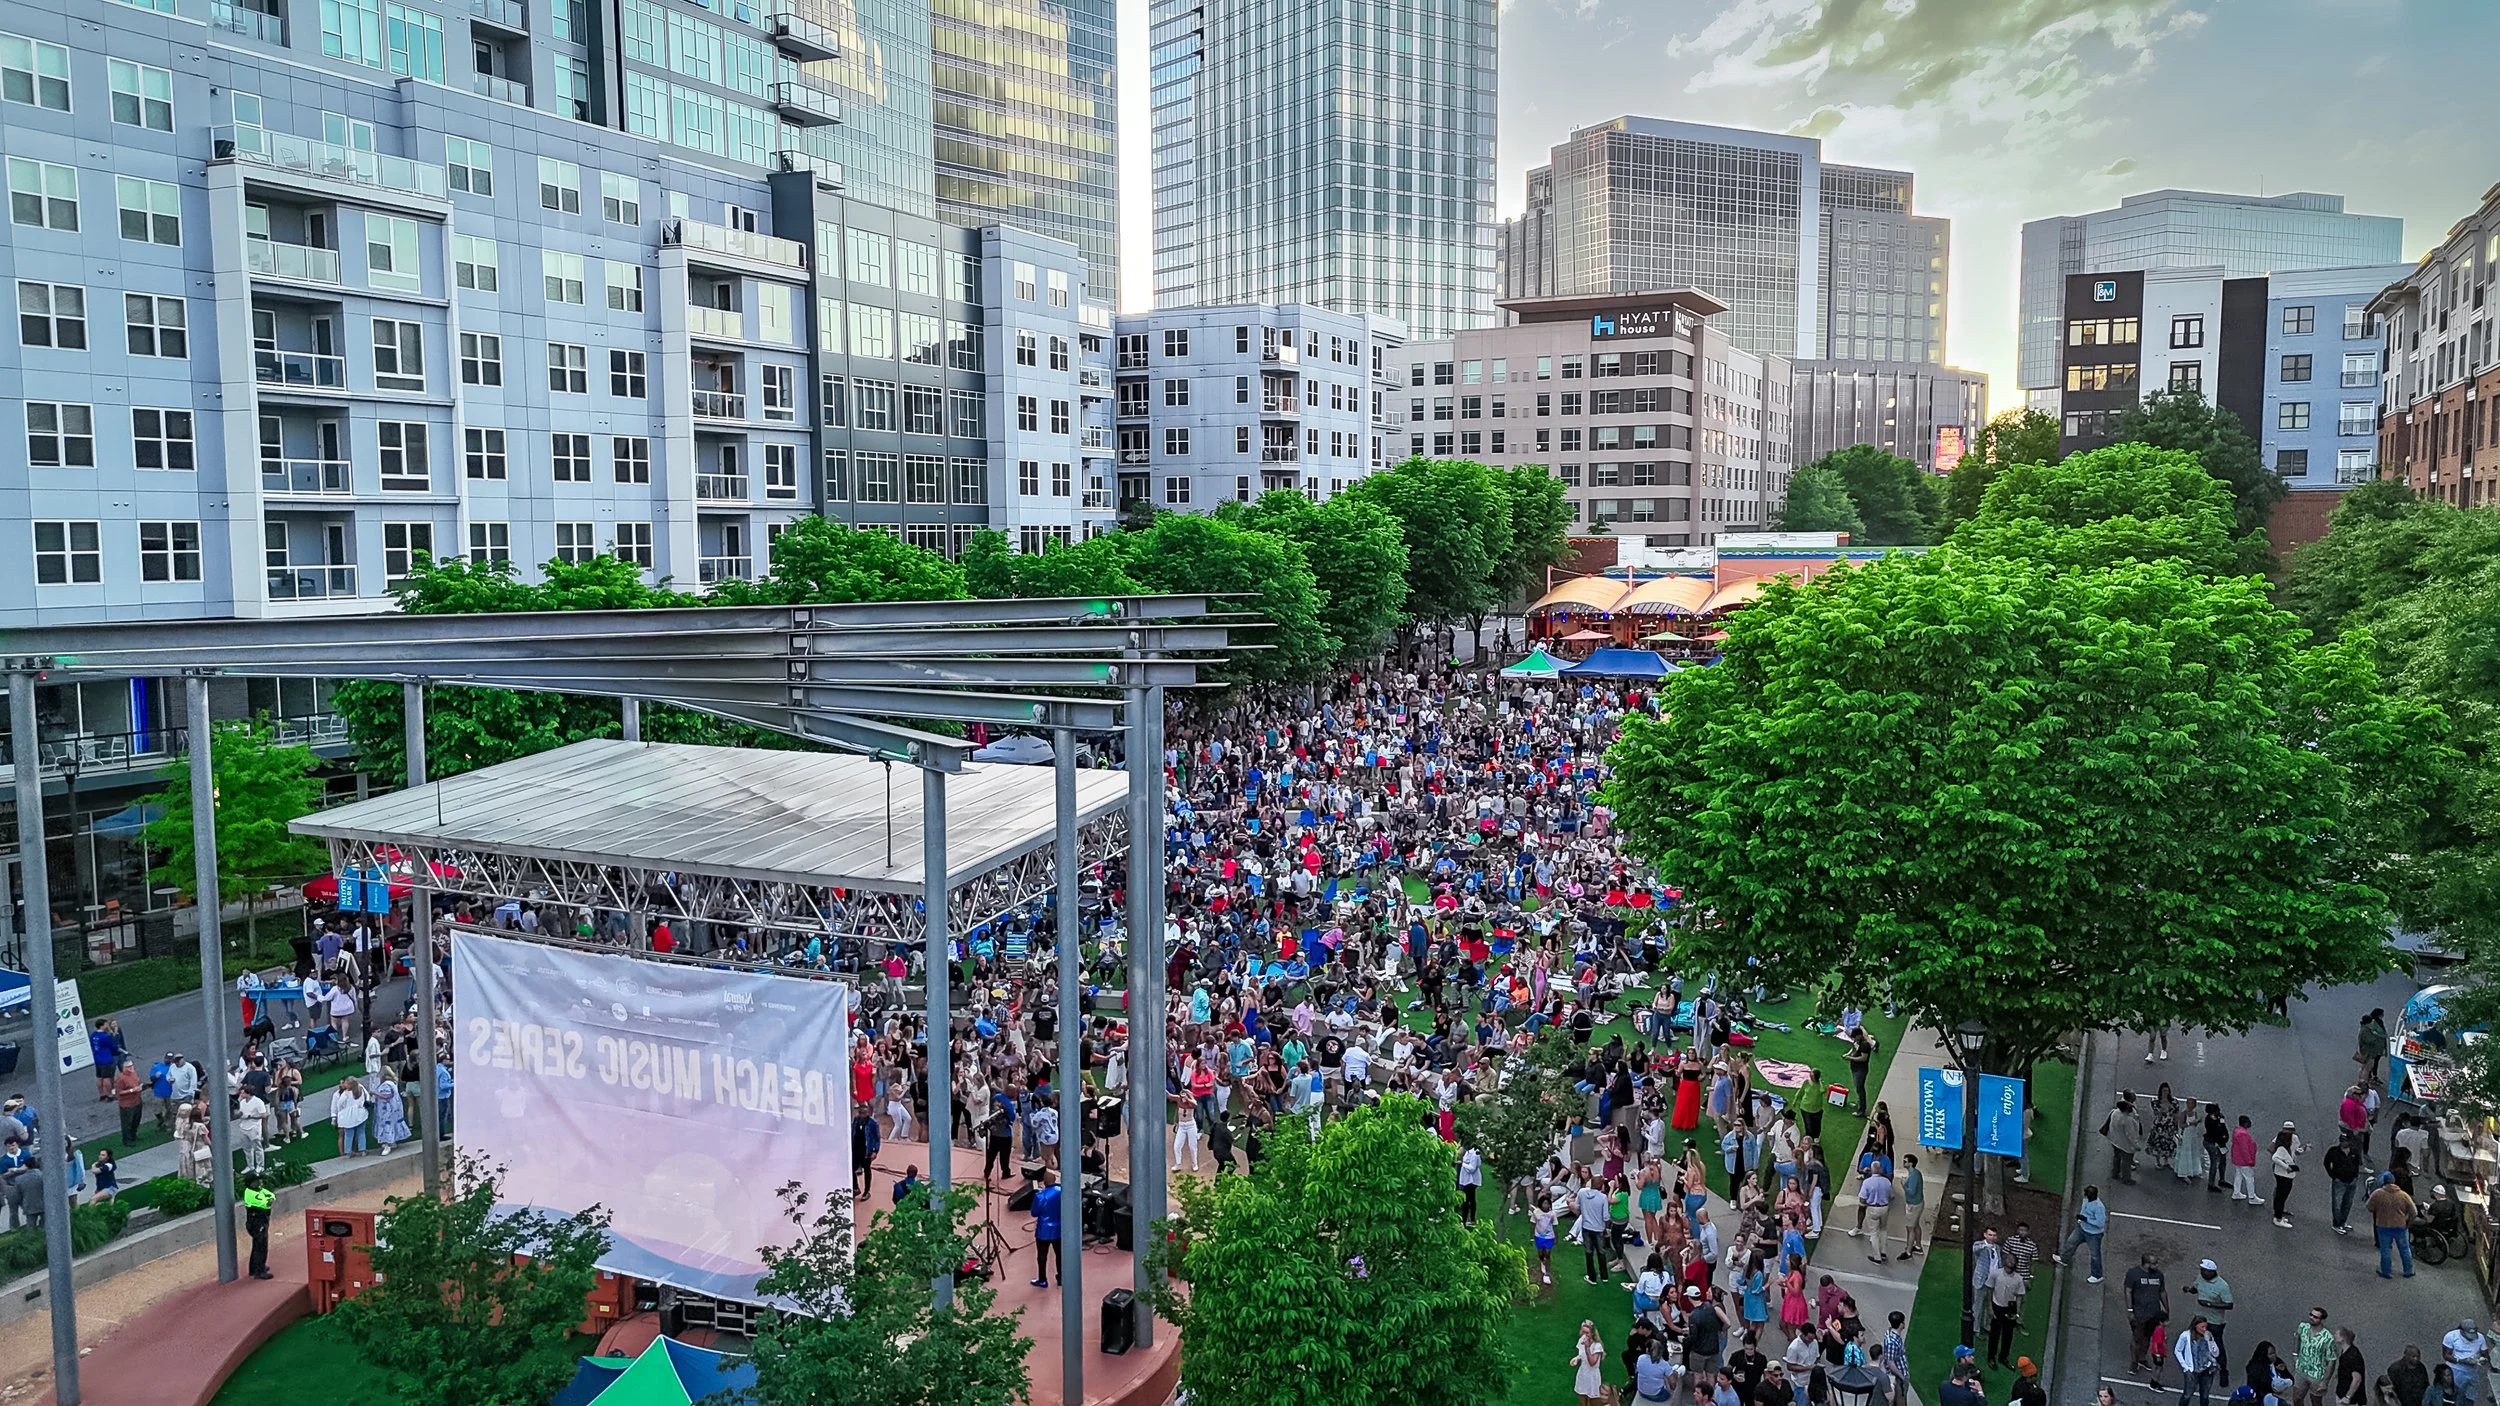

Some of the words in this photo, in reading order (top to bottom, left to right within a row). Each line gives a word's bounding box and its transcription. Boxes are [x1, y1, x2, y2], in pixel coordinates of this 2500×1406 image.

[1620, 311, 1671, 325] HYATT
[1620, 325, 1656, 335] house
[1924, 1079, 1934, 1139] MIDTOWN
[2001, 1084, 2015, 1116] enjoy.
[1935, 1108, 1945, 1140] PARK
[1991, 1124, 1999, 1141] place
